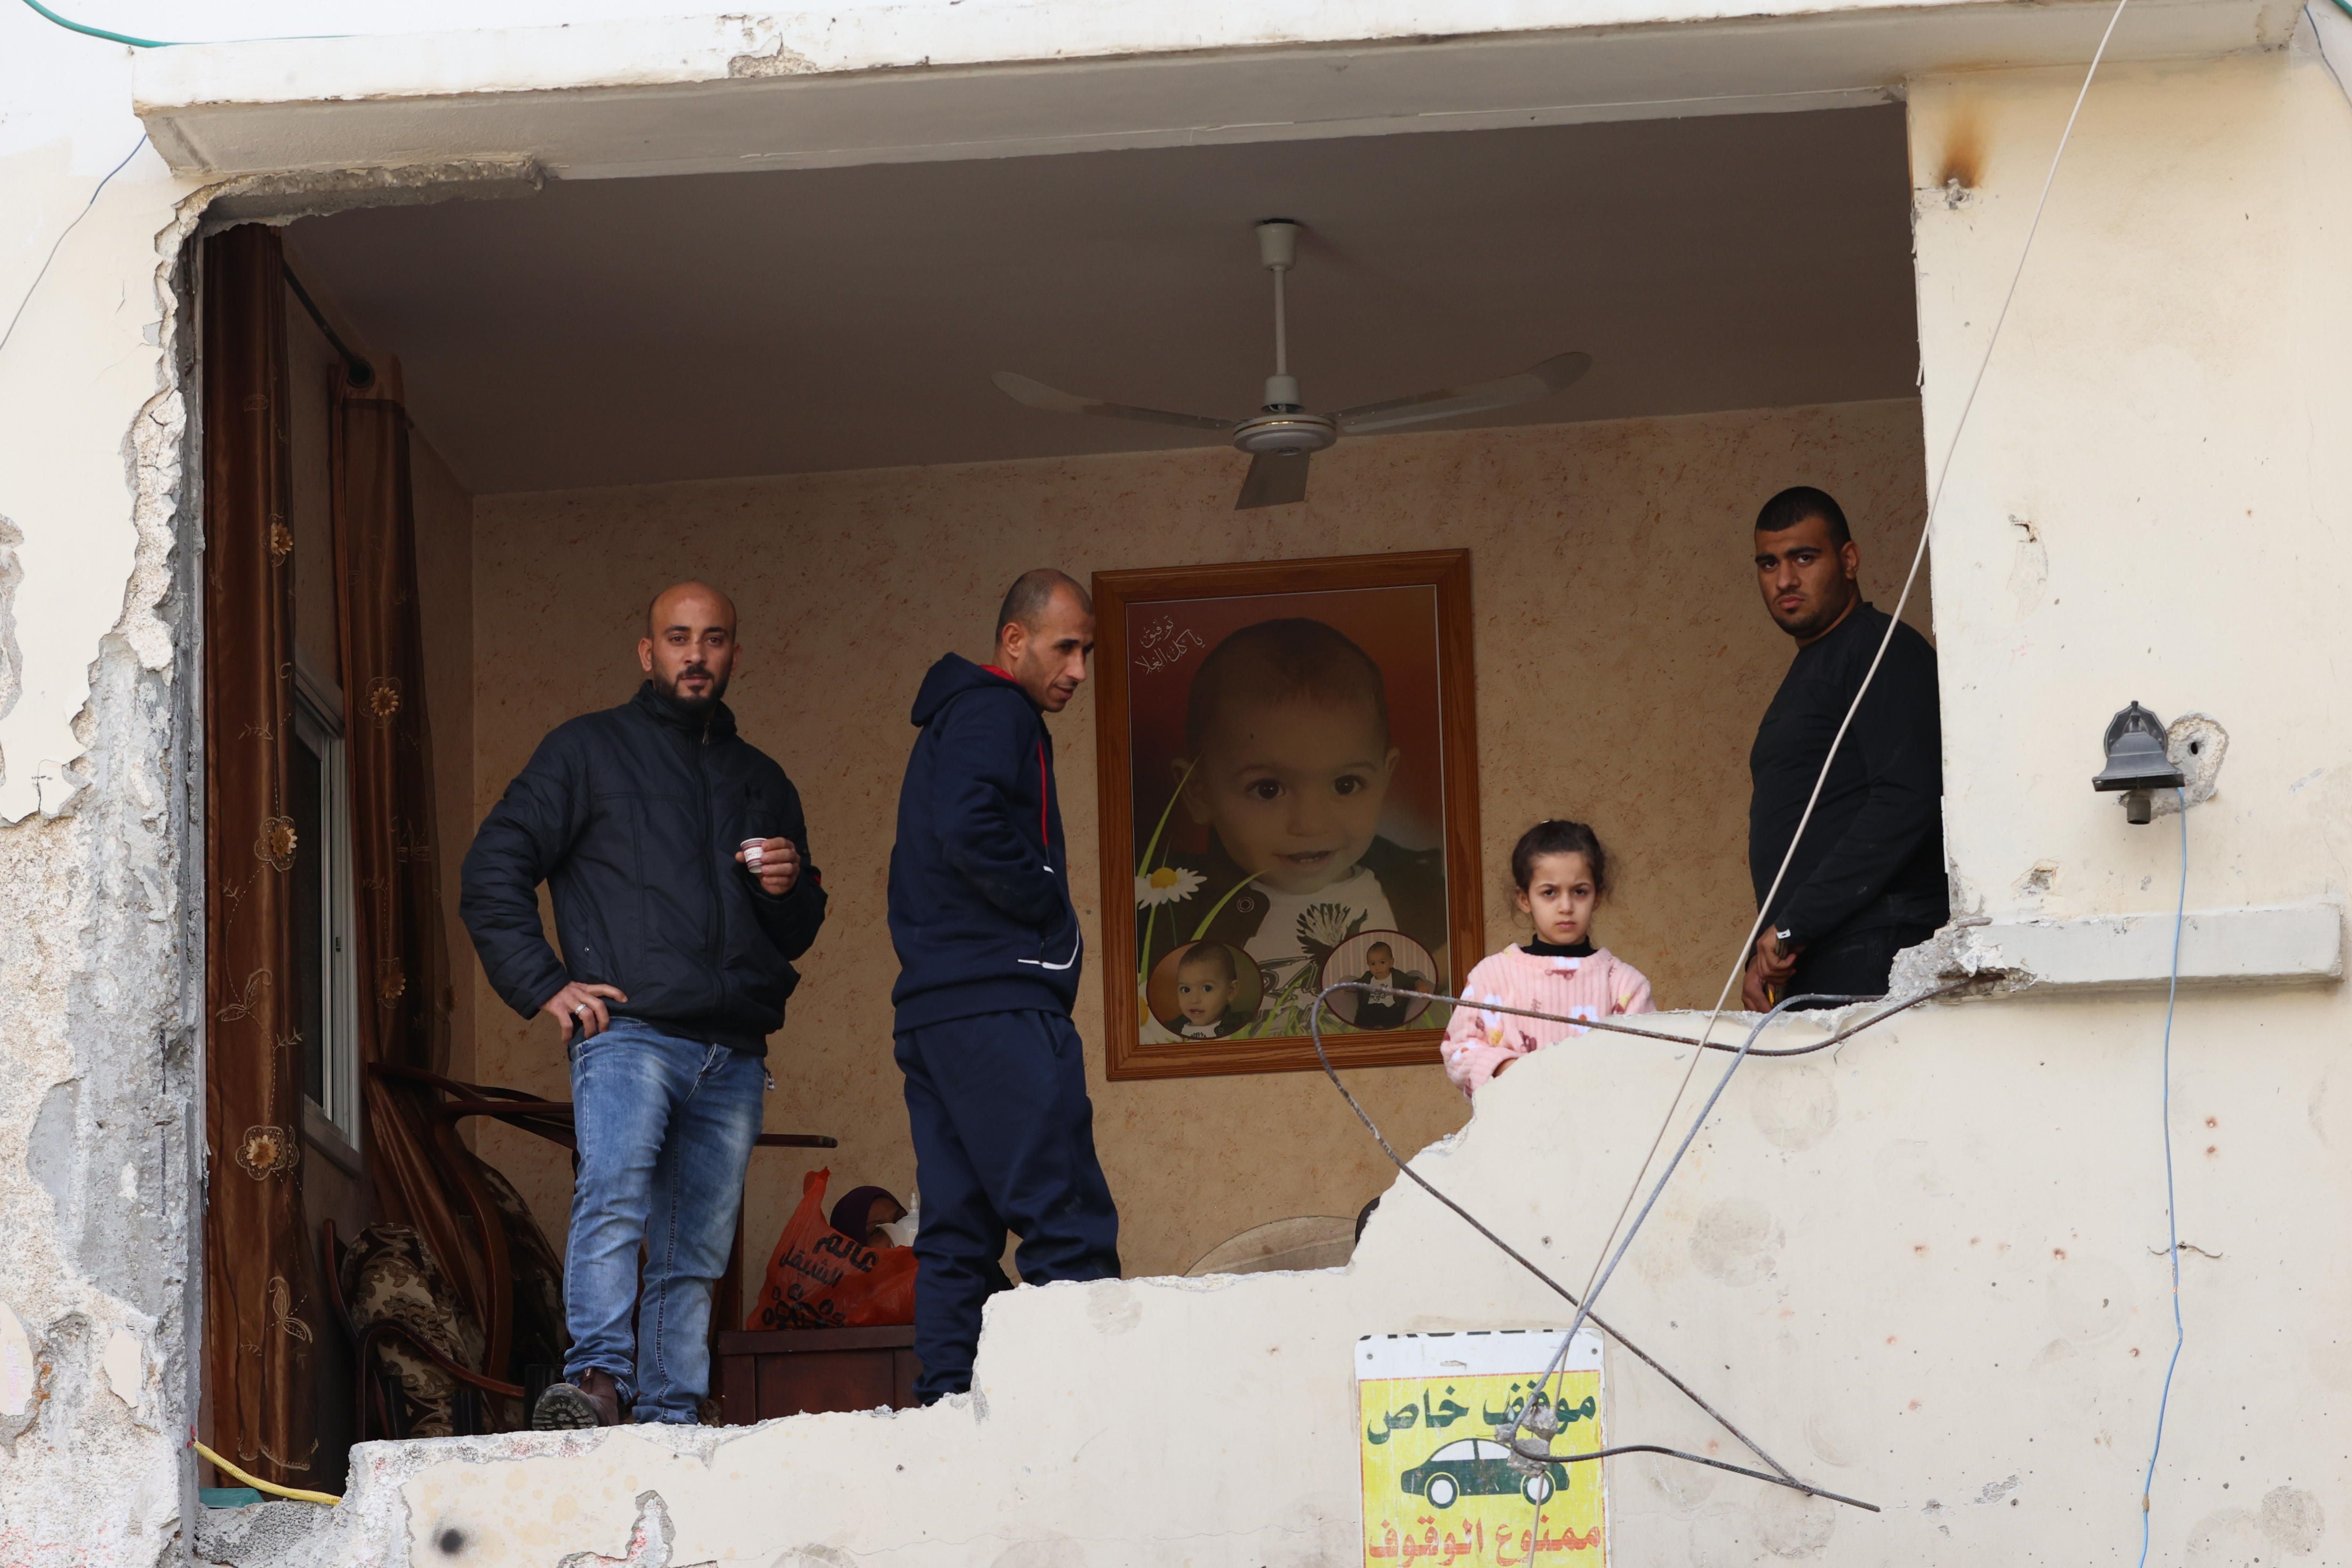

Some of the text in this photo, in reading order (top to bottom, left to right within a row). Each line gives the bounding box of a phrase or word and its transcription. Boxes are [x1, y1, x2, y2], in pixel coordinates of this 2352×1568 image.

[1140, 615, 1174, 648] توفيق
[1135, 647, 1168, 676] الغلا
[813, 1233, 880, 1273] عالم
[1367, 1379, 1597, 1445] موقف خاص
[1368, 1514, 1601, 1568] ممنوع الوقوف
